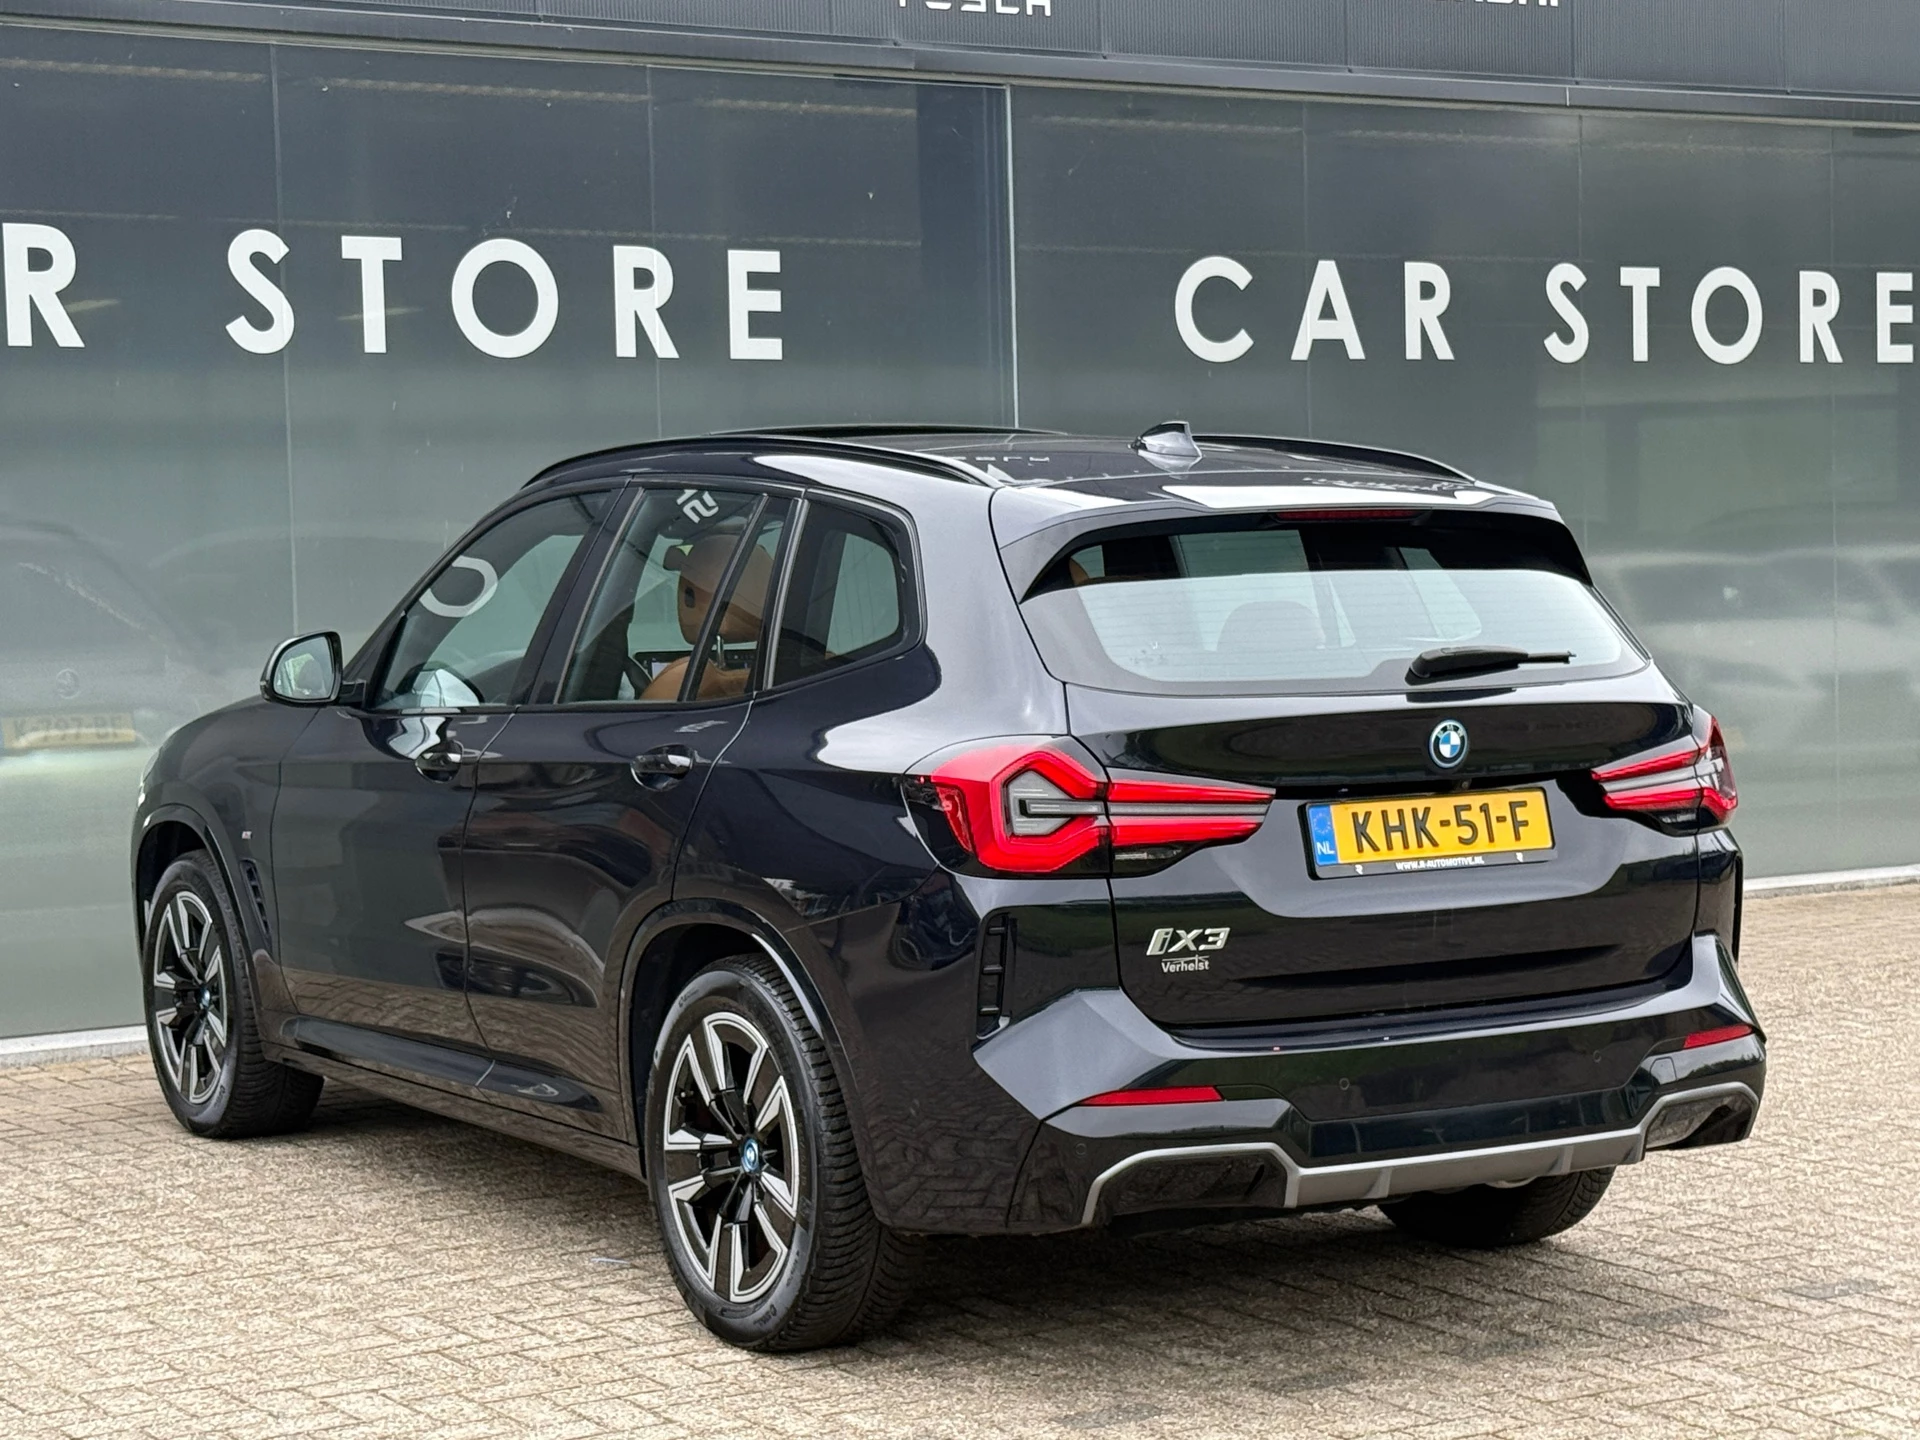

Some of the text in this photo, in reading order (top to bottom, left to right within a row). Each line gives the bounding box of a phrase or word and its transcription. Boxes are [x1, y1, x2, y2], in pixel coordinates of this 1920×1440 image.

[225, 229, 783, 360] STORE
[1174, 255, 1915, 366] CAR STORE
[1317, 801, 1529, 854] NL KHK-51-F
[1146, 927, 1230, 956] iX3
[1161, 958, 1209, 973] Verhelst
